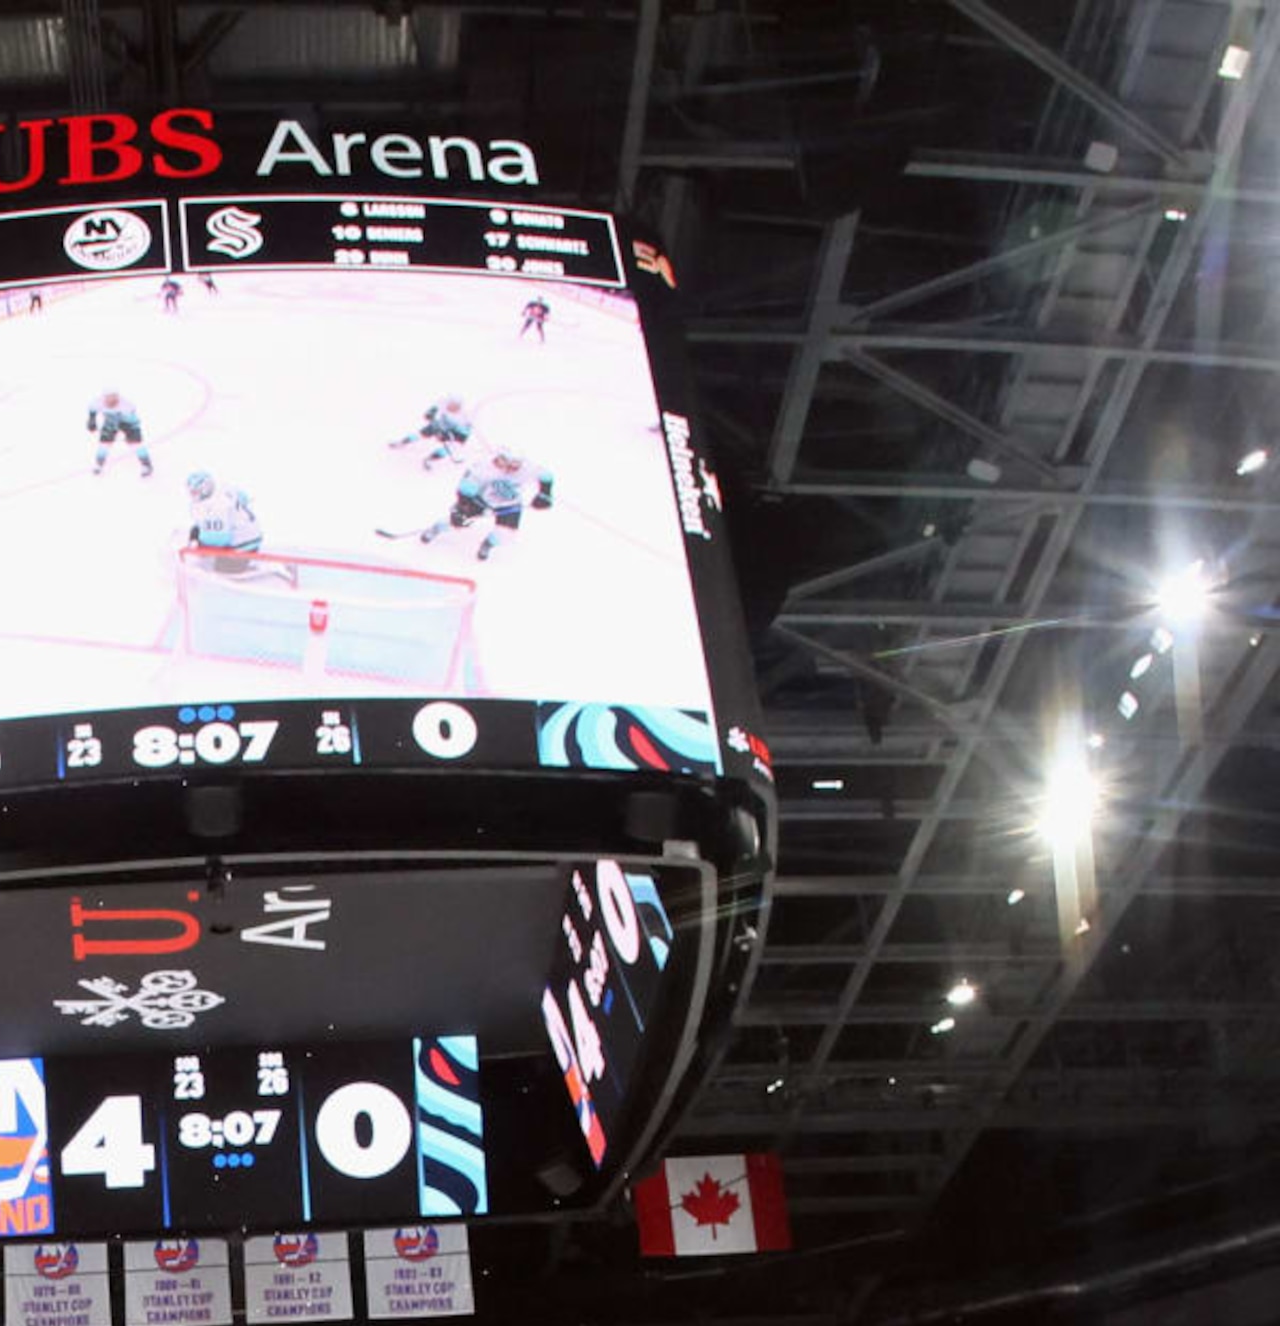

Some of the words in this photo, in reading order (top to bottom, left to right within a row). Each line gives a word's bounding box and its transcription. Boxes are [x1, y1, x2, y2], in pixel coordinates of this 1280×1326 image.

[256, 119, 539, 185] Arena
[484, 231, 511, 247] 17
[67, 738, 102, 768] 23
[132, 720, 280, 768] 8:07
[315, 725, 351, 754] 26
[412, 701, 478, 760] 0
[173, 1071, 206, 1100] 23
[257, 1067, 290, 1098] 26
[60, 1095, 156, 1189] 4
[178, 1109, 283, 1149] 8:07
[315, 1081, 412, 1179] 0
[263, 1288, 310, 1301] STANLEY
[311, 1287, 333, 1300] CUP
[384, 1283, 431, 1296] STANLEY
[433, 1281, 456, 1295] CUP
[22, 1299, 69, 1313] STANLEY
[71, 1298, 92, 1312] CUP
[143, 1293, 190, 1306] STANLEY
[192, 1292, 214, 1304] CUP
[389, 1298, 454, 1312] CHAMPIONS
[147, 1308, 211, 1323] CHAMPIONS
[267, 1303, 332, 1317] CHAMPIONS
